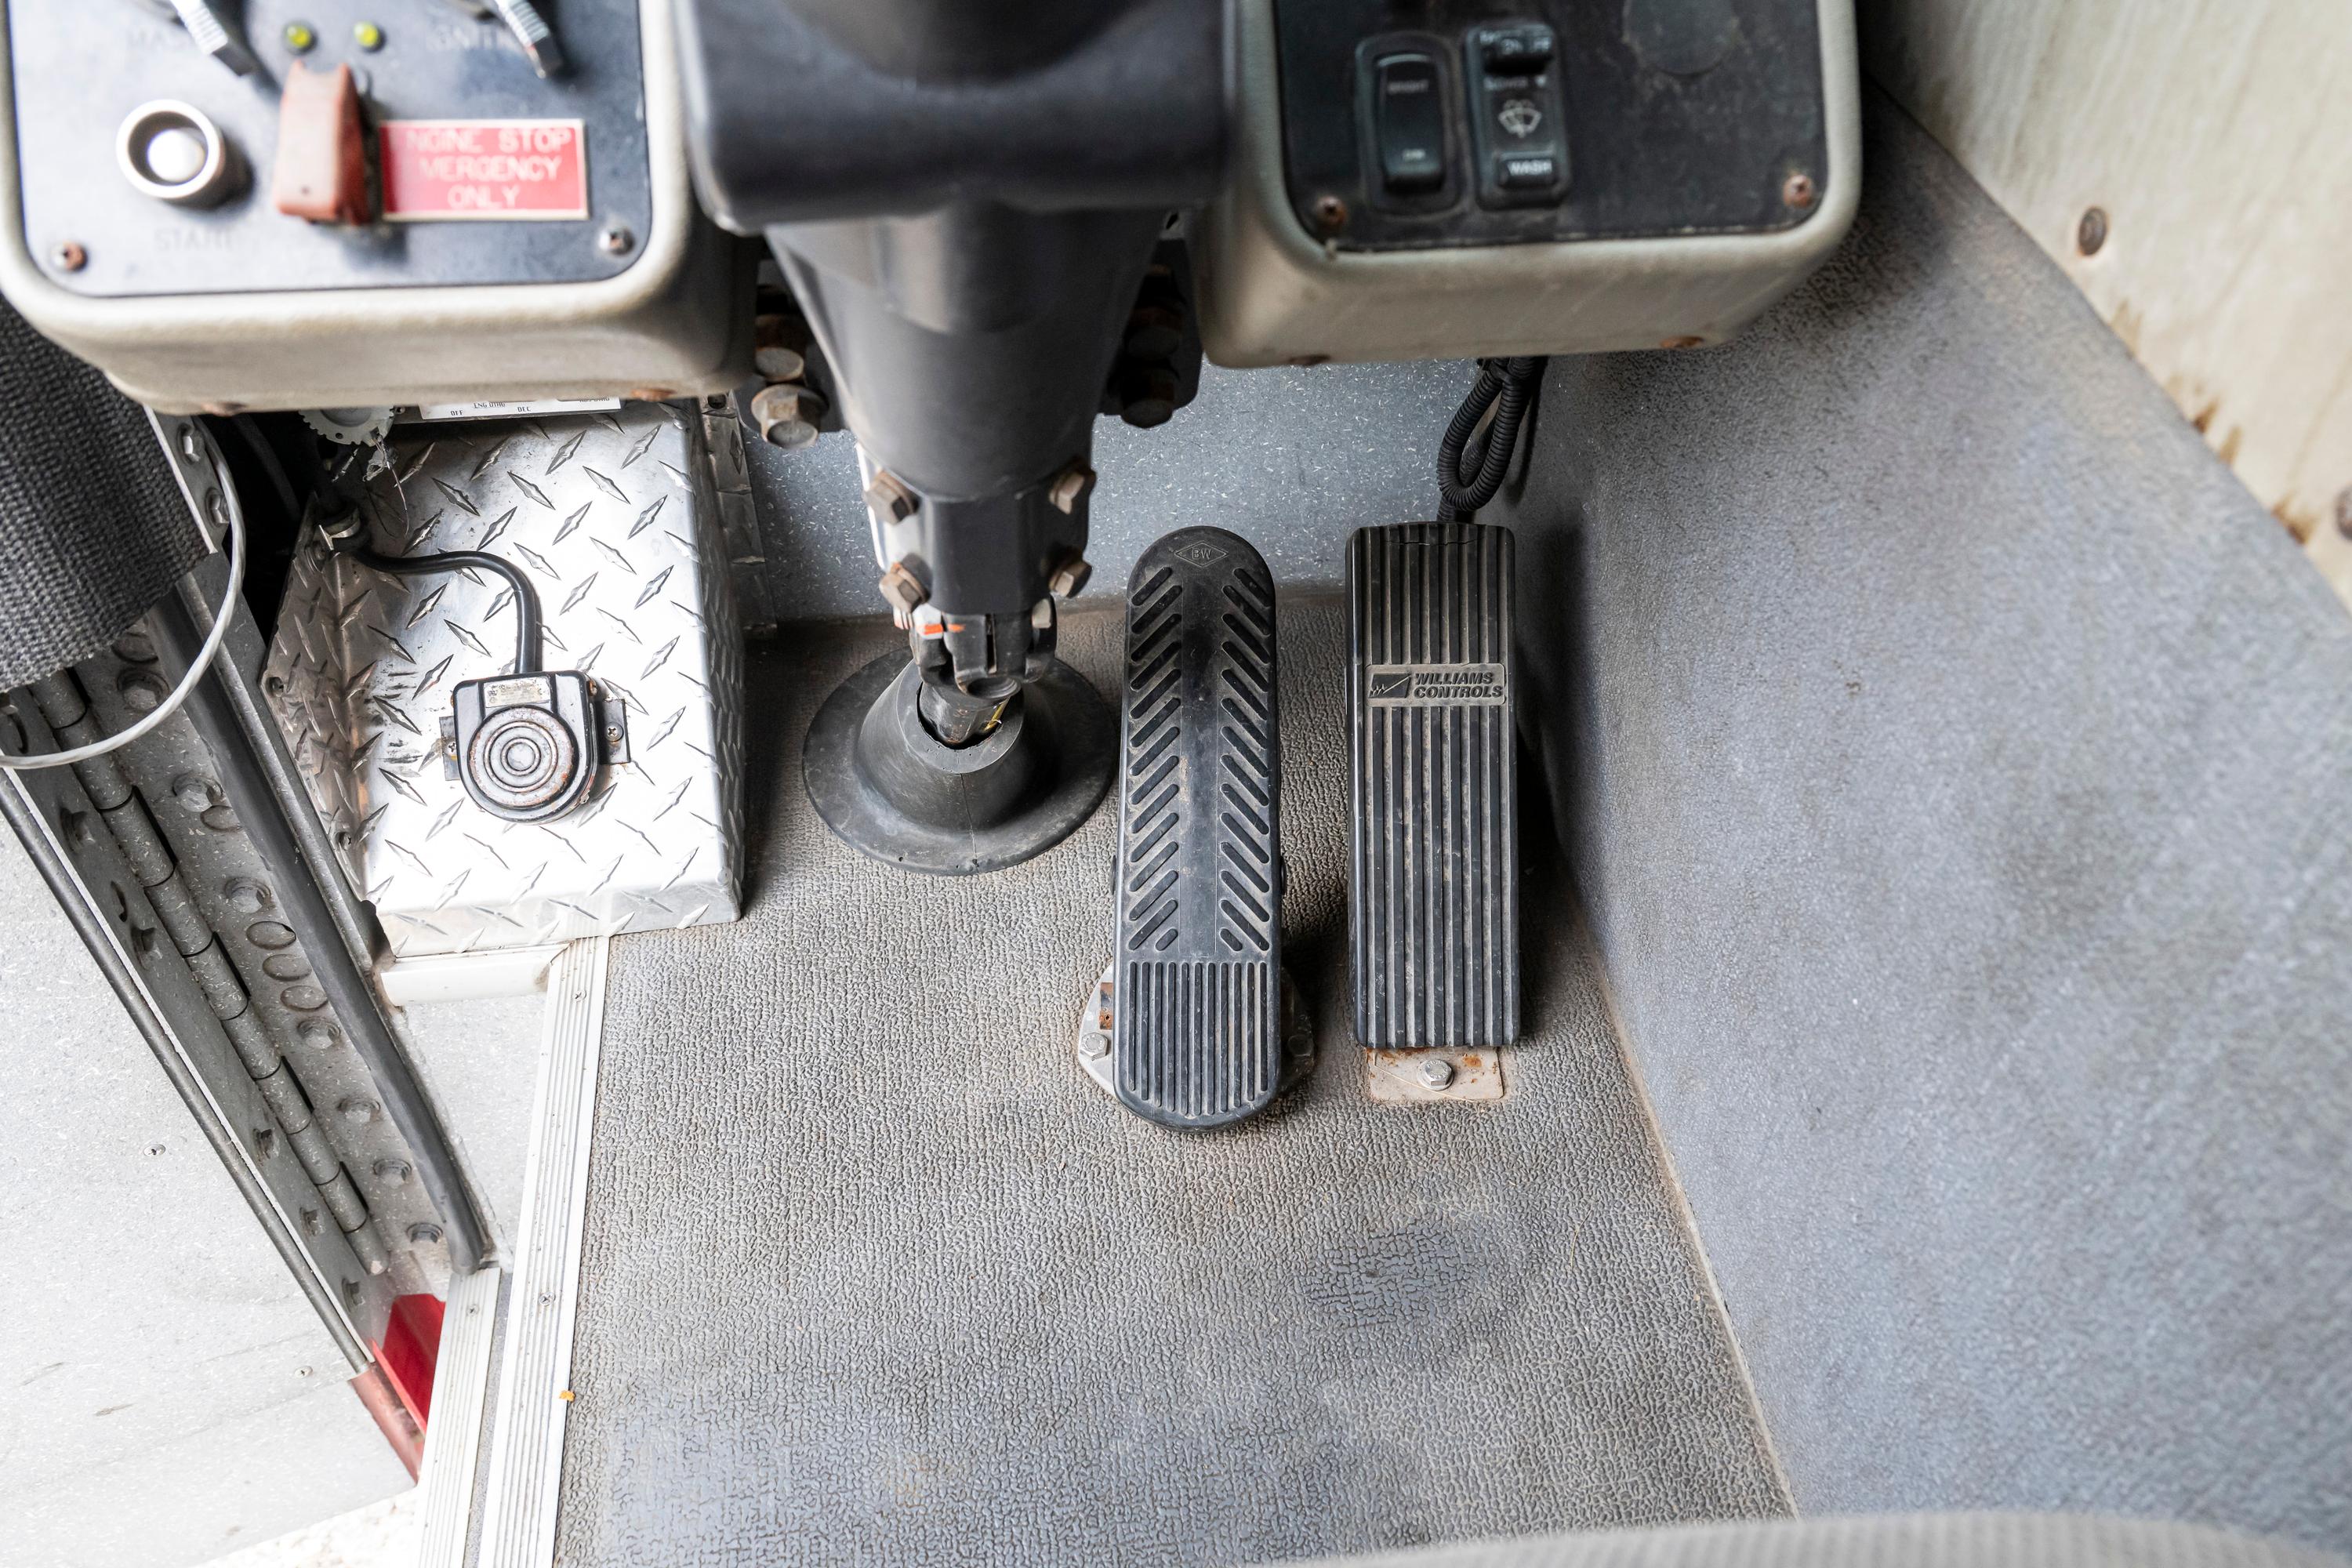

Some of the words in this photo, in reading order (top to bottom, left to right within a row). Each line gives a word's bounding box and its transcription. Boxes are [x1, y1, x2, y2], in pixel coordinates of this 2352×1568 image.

[405, 128, 484, 153] NGINE
[498, 128, 572, 153] STOP
[411, 156, 562, 182] MERGENCY
[1507, 159, 1553, 176] WASH
[447, 184, 521, 208] ONLY
[1192, 547, 1212, 560] BW
[1415, 673, 1494, 685] WILLIAMS
[1414, 685, 1503, 699] CONTROLS
